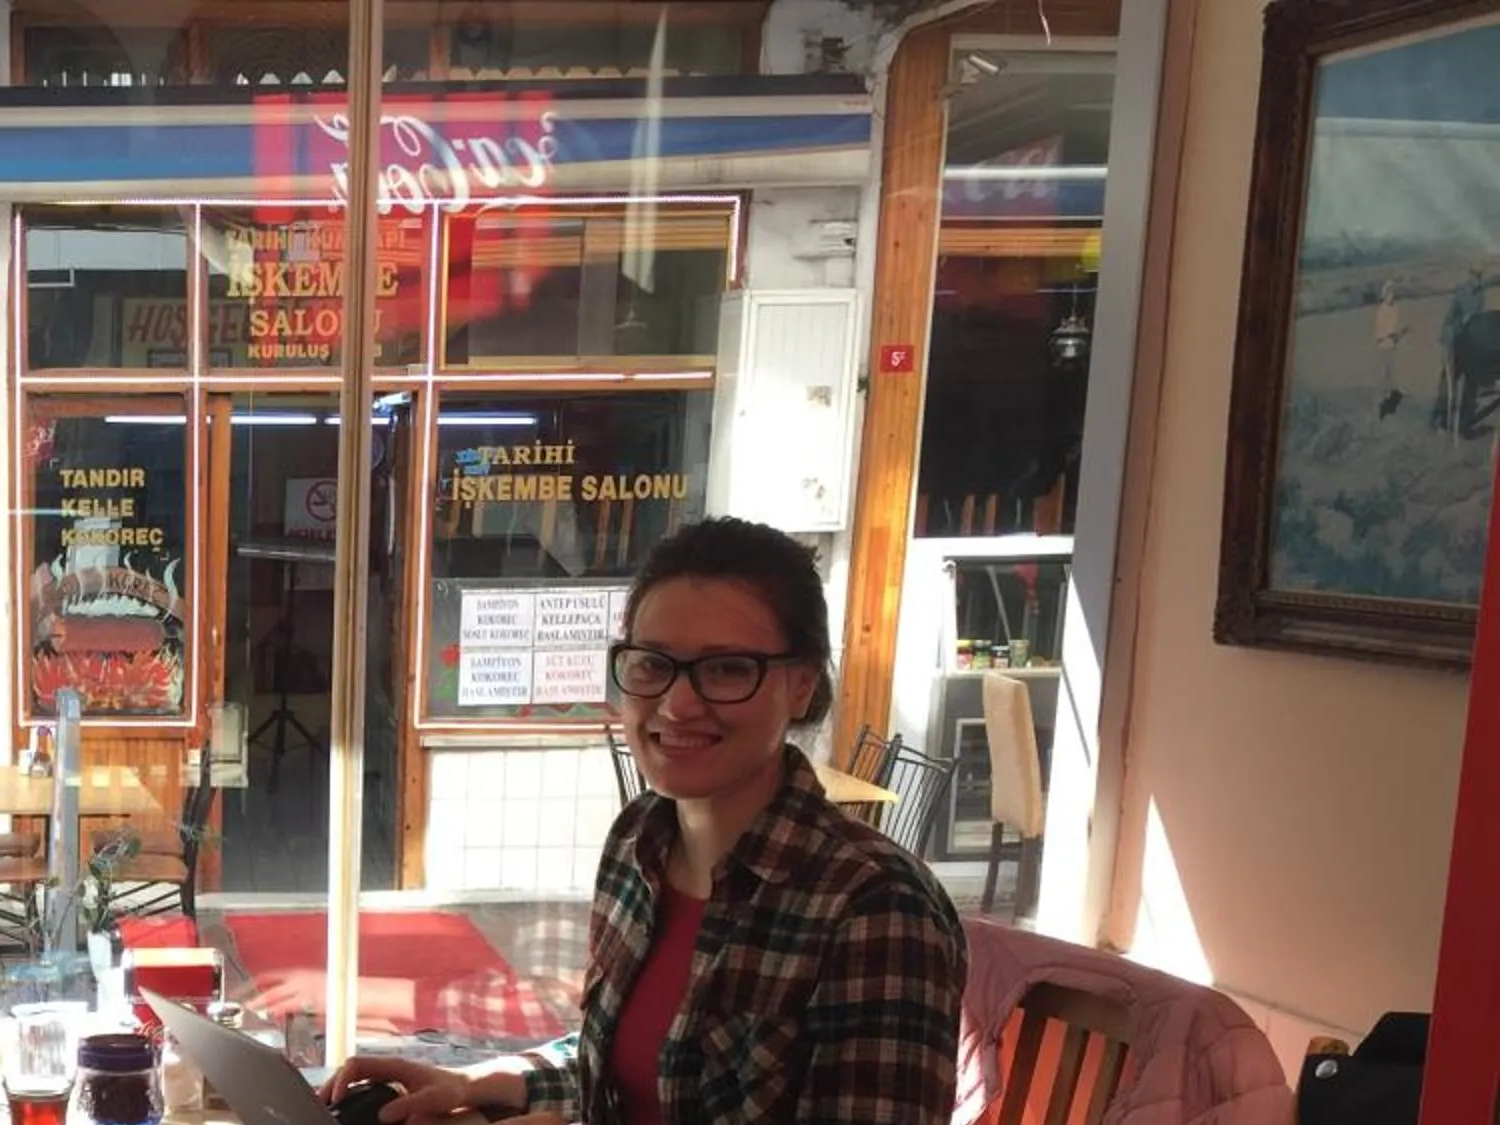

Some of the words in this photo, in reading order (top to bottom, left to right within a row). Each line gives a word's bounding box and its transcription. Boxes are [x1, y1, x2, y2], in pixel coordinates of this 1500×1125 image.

[227, 256, 398, 304] İŞKEME
[249, 309, 384, 337] SALO
[476, 439, 576, 465] TARİHİ
[59, 468, 146, 488] TANDIR
[451, 468, 573, 509] İŞKEMBE
[581, 474, 689, 500] SALONU
[60, 497, 135, 517] KELLE
[60, 527, 164, 552] KOKOREÇ
